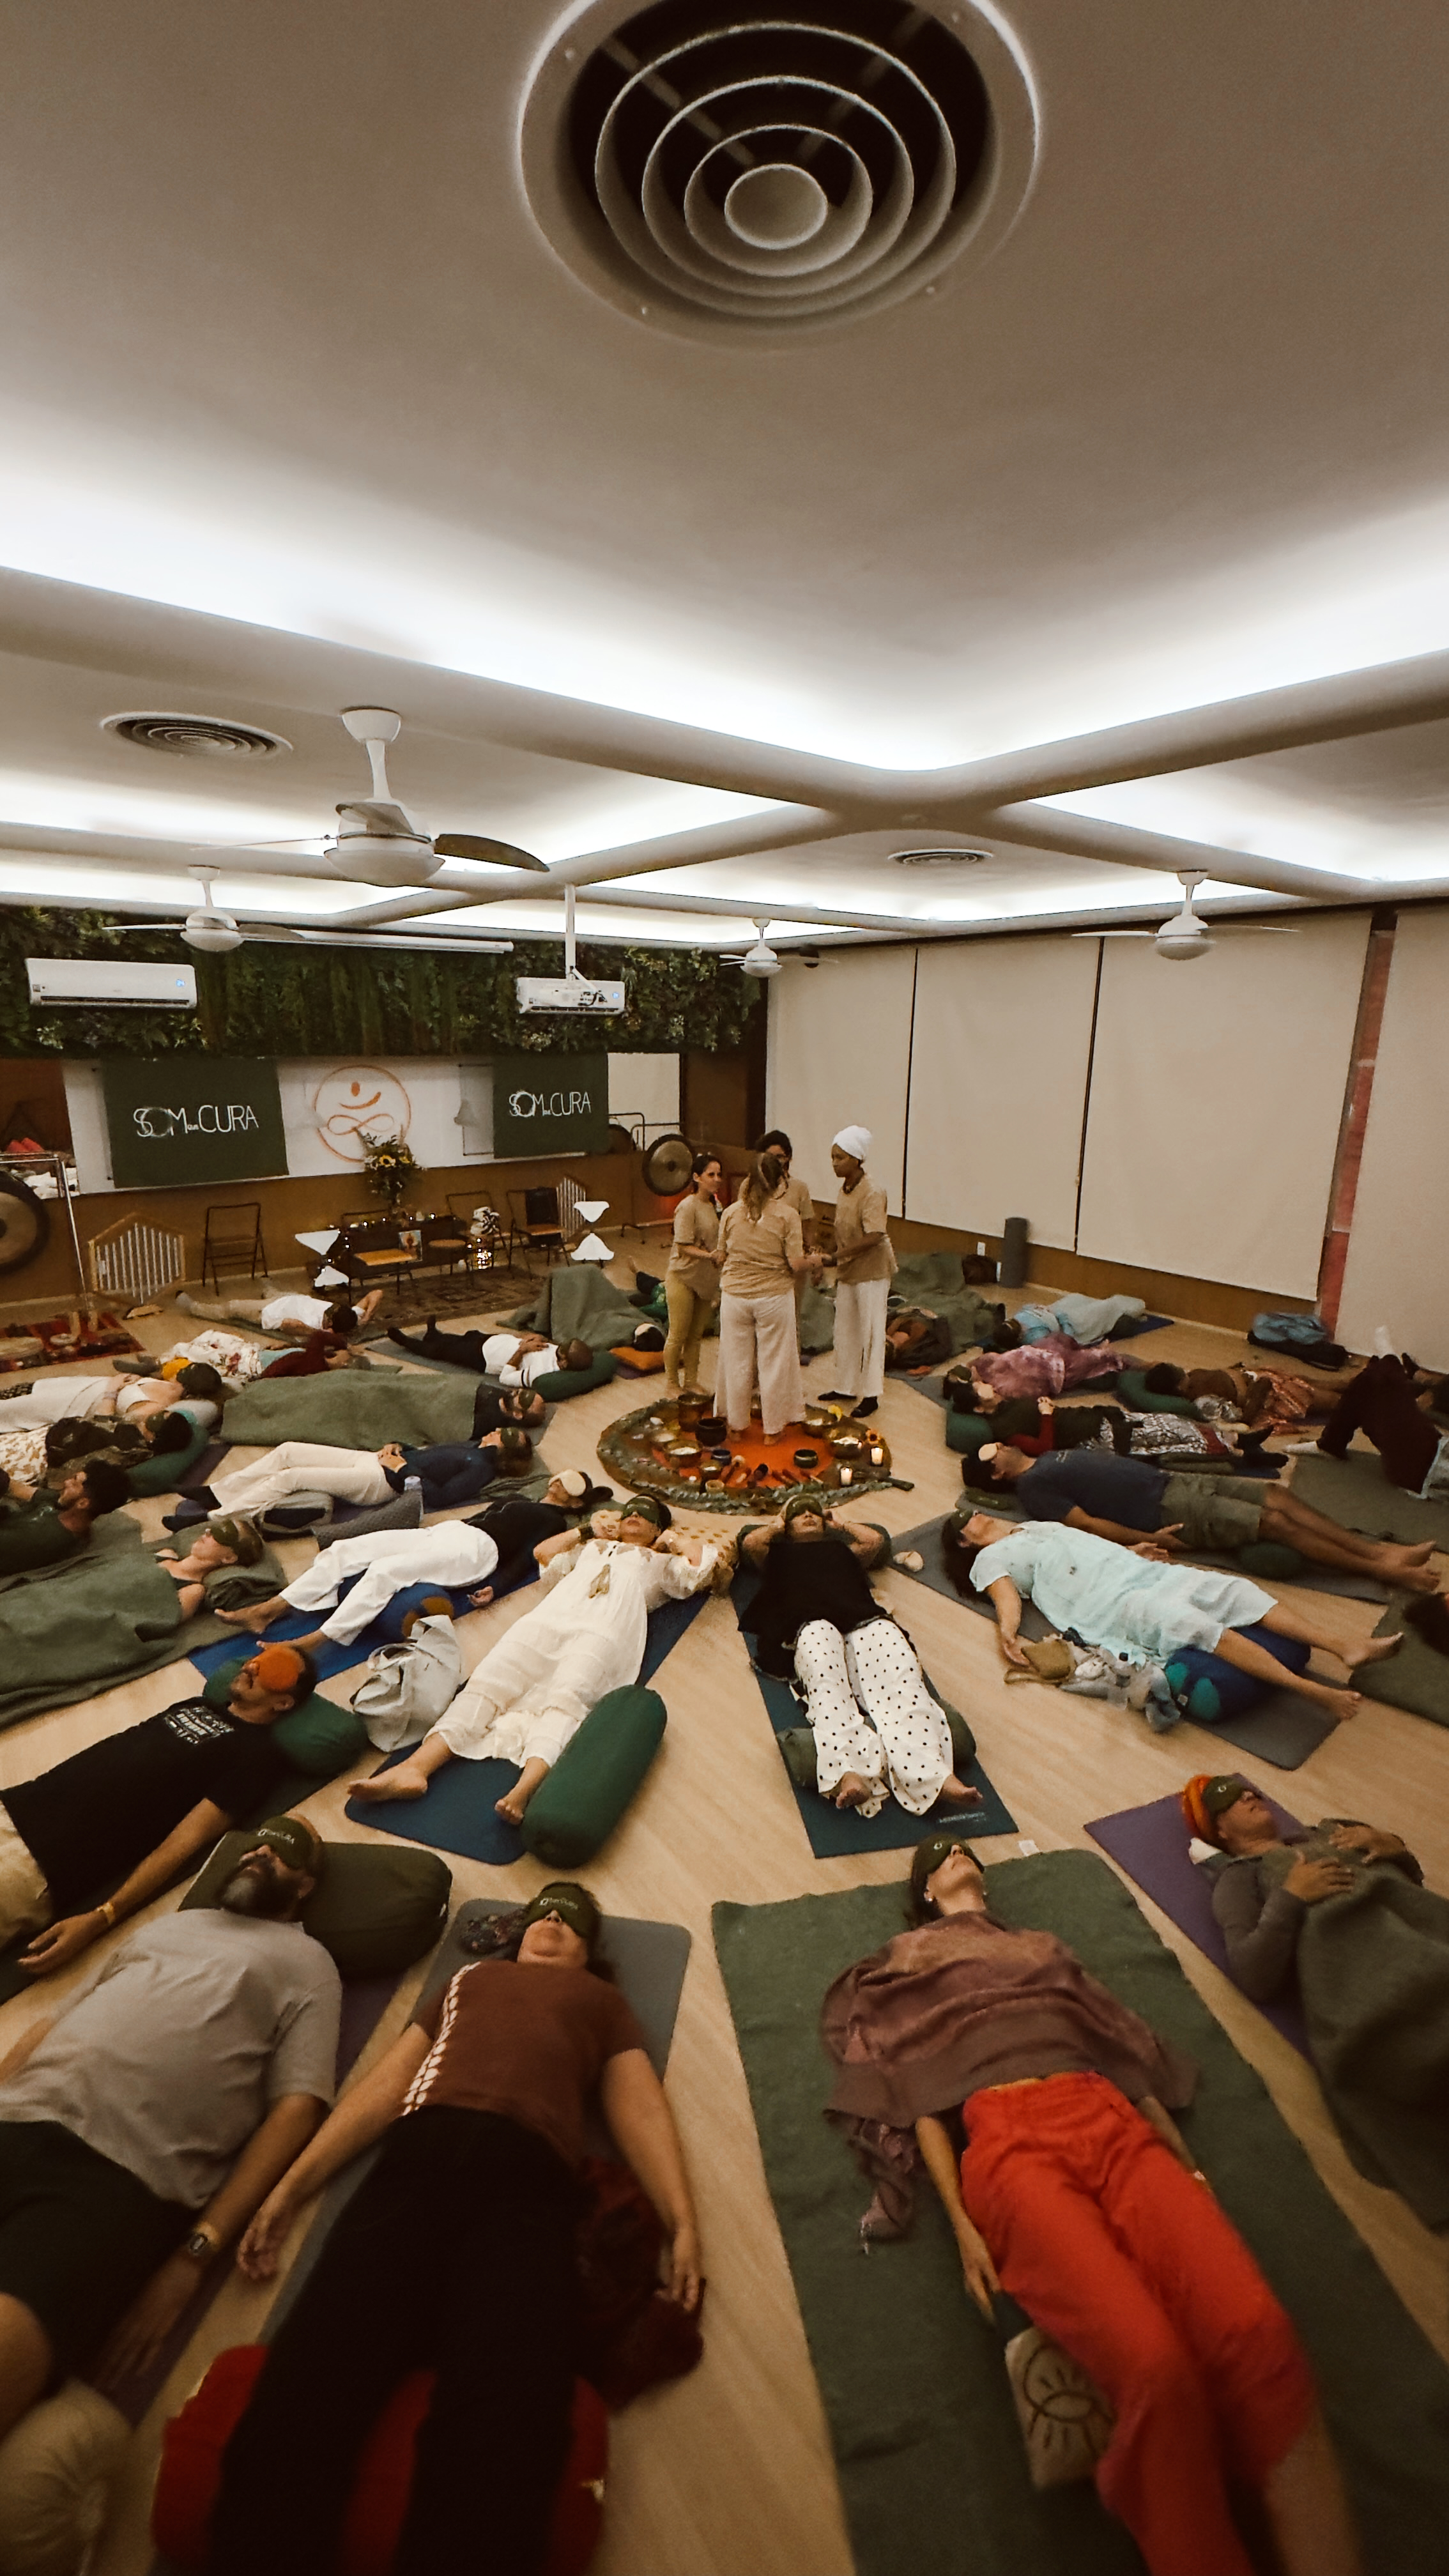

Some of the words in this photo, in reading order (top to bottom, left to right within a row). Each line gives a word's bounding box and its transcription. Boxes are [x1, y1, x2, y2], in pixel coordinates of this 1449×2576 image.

[509, 1090, 544, 1117] SOM
[550, 1091, 591, 1116] CURA
[134, 1107, 188, 1137] SOM
[198, 1105, 259, 1132] CURA
